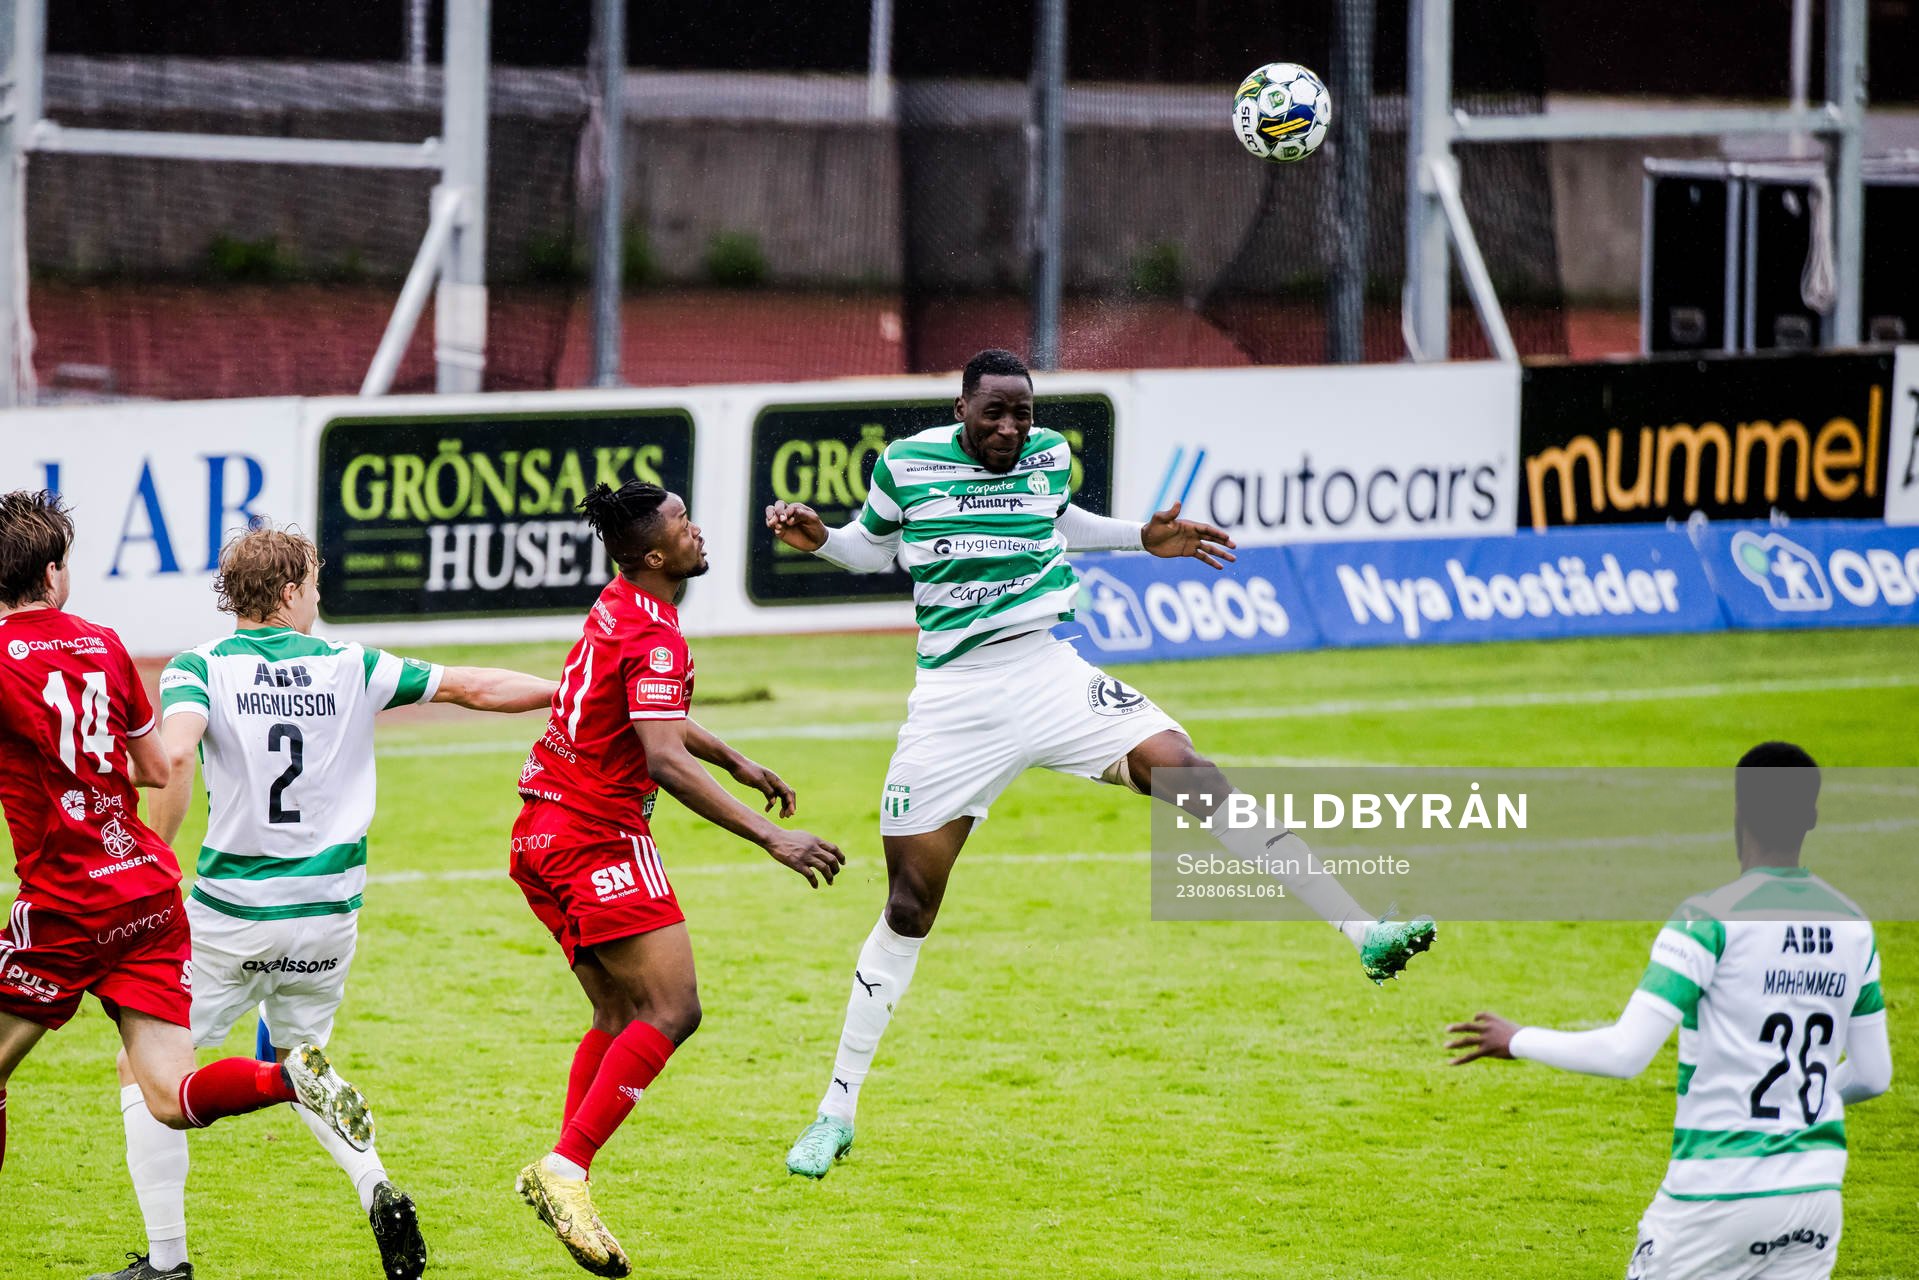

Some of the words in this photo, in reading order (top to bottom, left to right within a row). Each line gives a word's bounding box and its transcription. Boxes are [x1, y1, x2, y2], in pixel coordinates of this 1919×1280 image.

[341, 438, 664, 522] GRÖNSAKS
[1209, 451, 1499, 529] autocars
[1526, 384, 1882, 533] mummel
[106, 453, 266, 577] AB
[956, 495, 1025, 512] Kinnarps
[425, 520, 611, 591] HUSET
[1828, 547, 1919, 608] OB
[1144, 576, 1291, 644] OBOS
[1336, 563, 1453, 640] Nya
[1446, 552, 1679, 623] bostäder
[236, 692, 336, 717] MAGNUSSON
[253, 663, 313, 688] ABB
[640, 683, 679, 695] UNIBET
[42, 670, 116, 774] 14
[267, 723, 304, 824] 2
[591, 862, 635, 896] SN
[1782, 926, 1834, 954] ABB
[6, 964, 60, 997] PULS
[180, 959, 192, 986] S
[1763, 970, 1847, 998] MAHAMMED
[1751, 1012, 1834, 1125] 26
